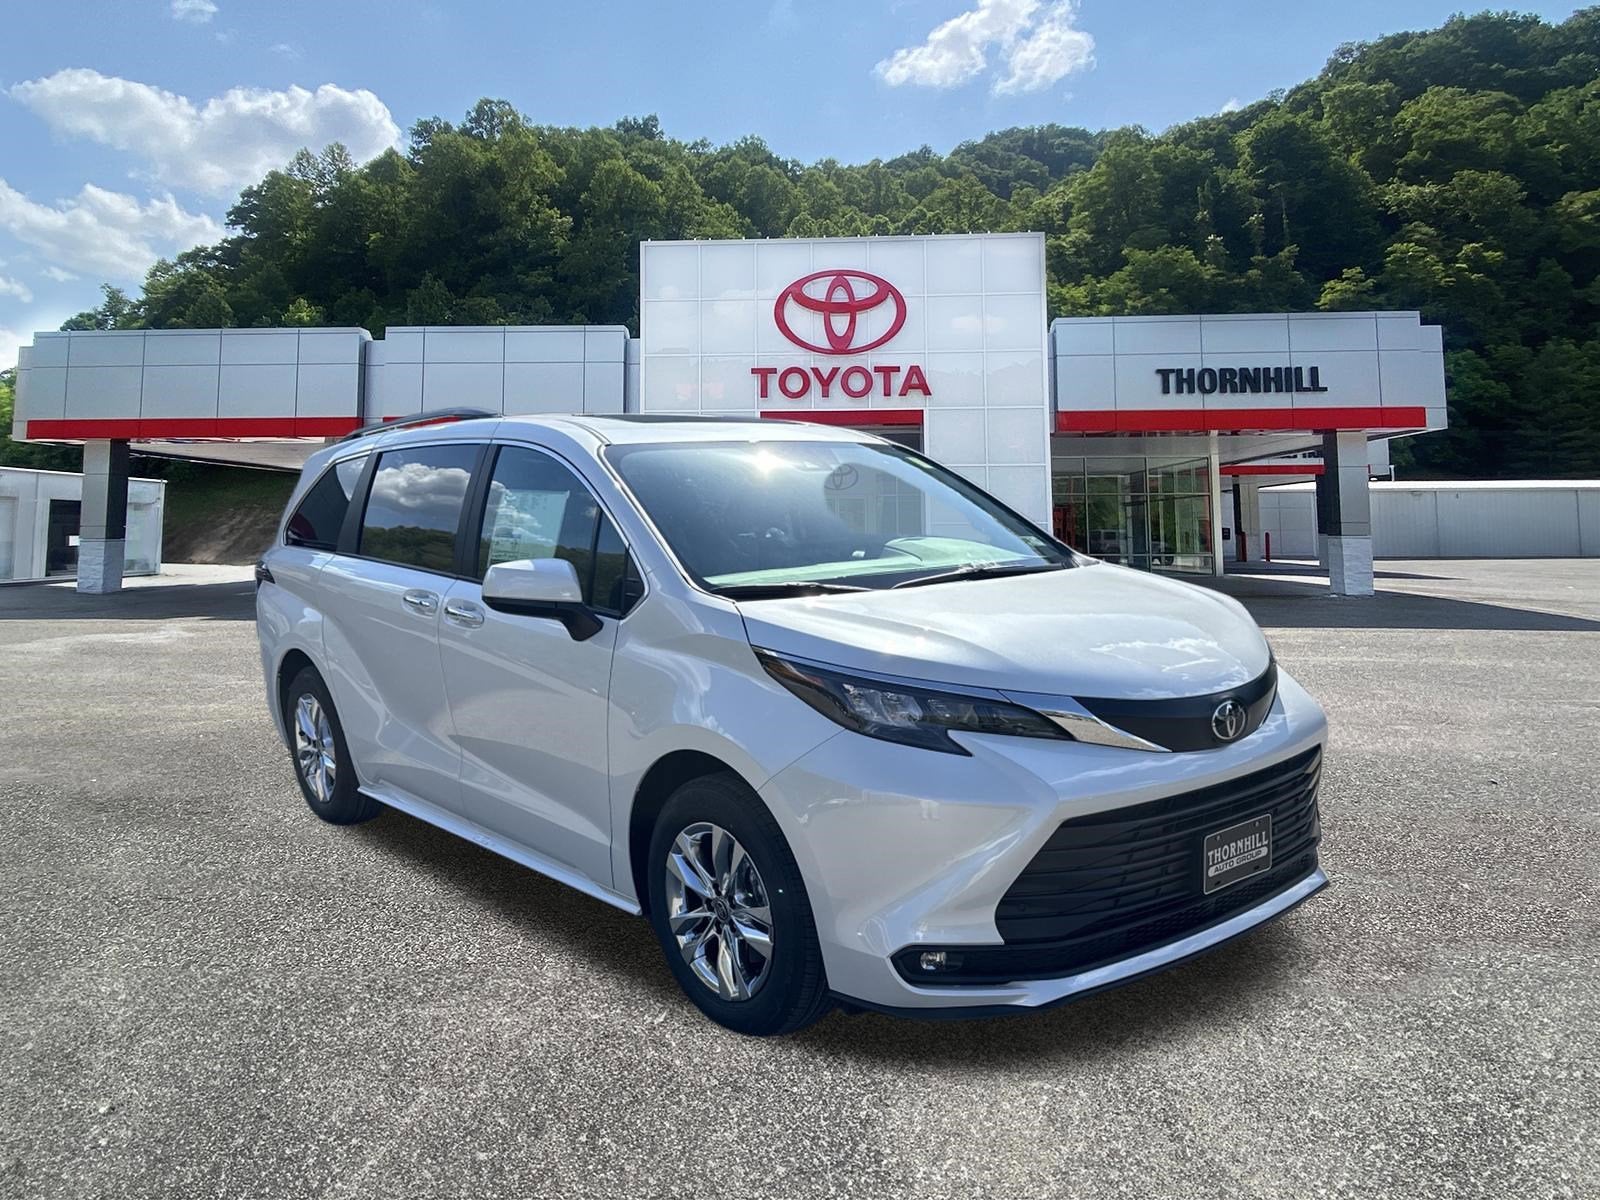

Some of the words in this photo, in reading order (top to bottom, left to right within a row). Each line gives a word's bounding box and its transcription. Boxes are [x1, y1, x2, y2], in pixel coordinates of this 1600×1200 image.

[751, 365, 932, 399] TOYOTA
[1155, 366, 1328, 394] THORNHILL
[1207, 831, 1269, 866] THORNHILL
[1214, 859, 1235, 874] AUTO
[1236, 849, 1263, 865] GROUP
